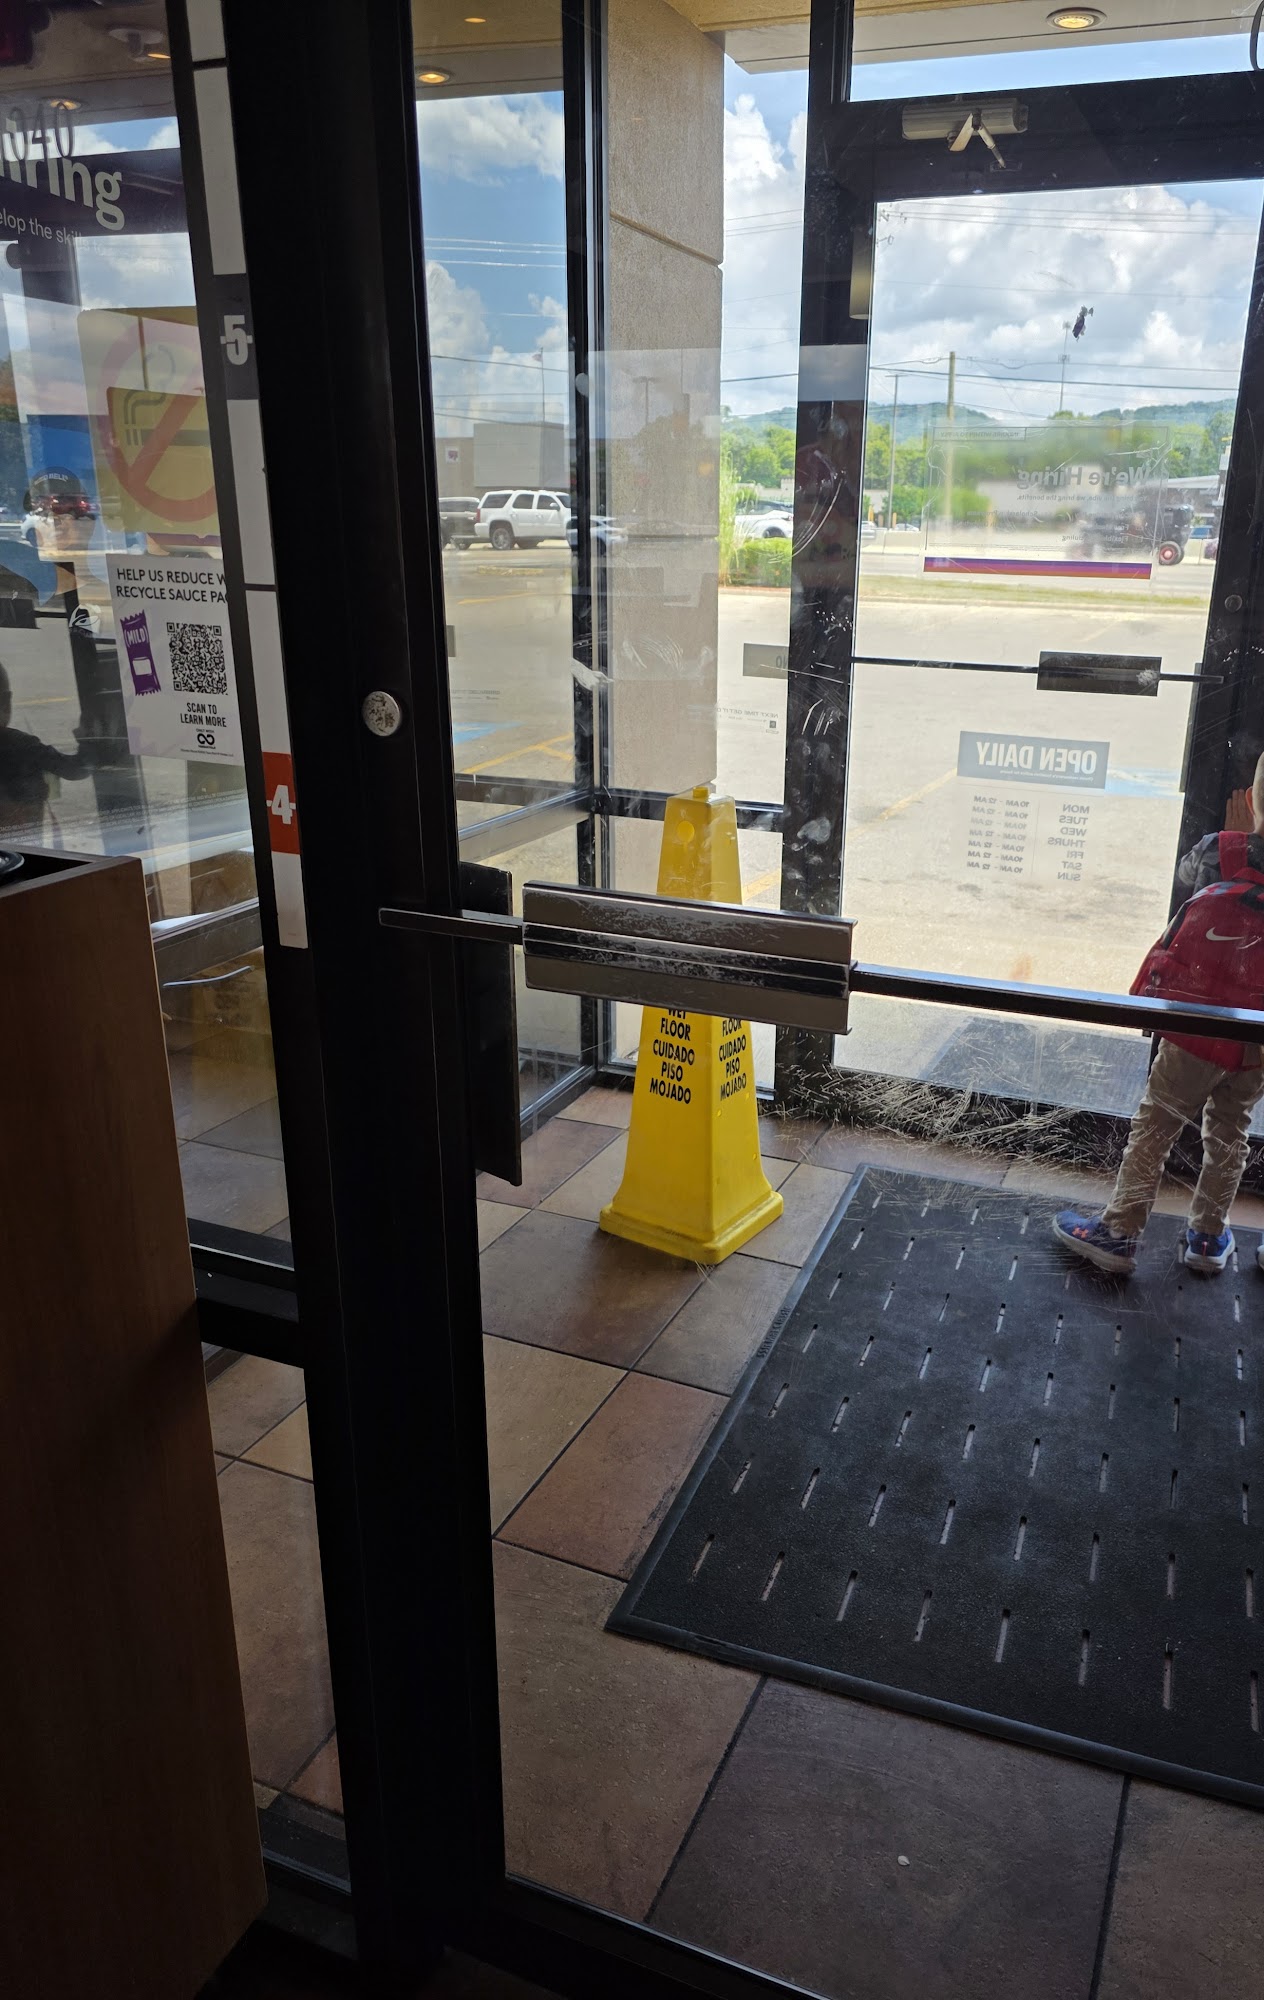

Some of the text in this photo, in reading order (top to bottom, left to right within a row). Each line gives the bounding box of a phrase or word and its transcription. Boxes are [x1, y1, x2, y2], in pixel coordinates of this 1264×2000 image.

[0, 118, 125, 231] iring
[29, 217, 53, 240] the
[222, 314, 250, 366] 5
[117, 568, 146, 582] HELP
[149, 570, 164, 582] US
[167, 571, 215, 585] REDUCE
[116, 585, 166, 600] RECYCLE
[169, 588, 208, 602] SAUCE
[186, 702, 217, 715] SCAN TO
[180, 714, 227, 728] LEARN MORE
[269, 784, 295, 825] 4
[660, 1018, 691, 1041] FLOOR
[722, 1018, 742, 1037] FLOOR
[653, 1039, 695, 1066] CUIDADO
[719, 1034, 747, 1062] CUIDADO
[661, 1061, 683, 1082] PISO
[725, 1057, 740, 1078] PISO
[649, 1078, 691, 1104] MOJADO
[720, 1073, 747, 1102] MOJADO
